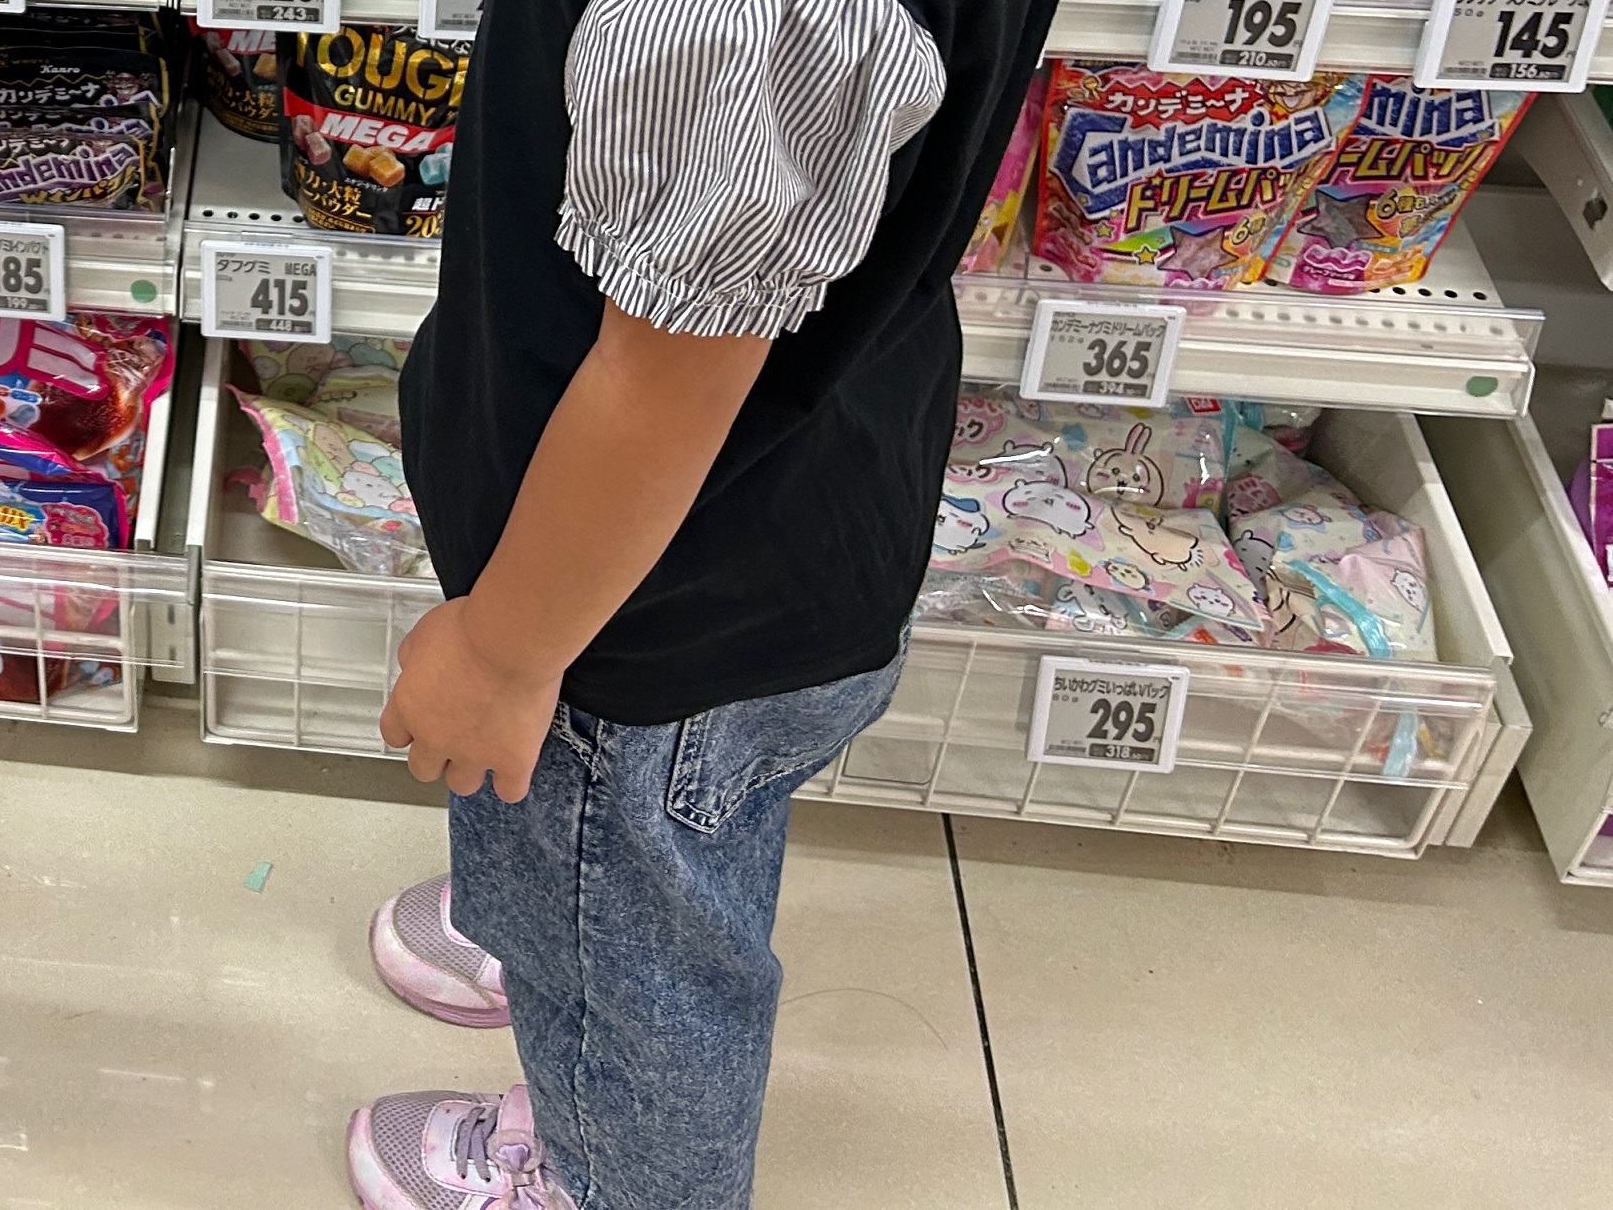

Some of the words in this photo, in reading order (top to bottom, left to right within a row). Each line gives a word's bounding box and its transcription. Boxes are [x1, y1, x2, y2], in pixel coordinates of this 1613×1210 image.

[1494, 11, 1575, 58] 145
[39, 65, 80, 75] Kanro
[334, 84, 438, 127] GUMMY
[320, 113, 437, 152] MEGA
[1054, 108, 1327, 214] Candemina
[217, 259, 270, 274] タフグミ
[285, 262, 317, 277] MEGA
[250, 278, 309, 316] 415
[1083, 338, 1152, 379] 365
[1054, 676, 1171, 699] ちいかわグミいっぱいパック
[1087, 698, 1157, 742] 295
